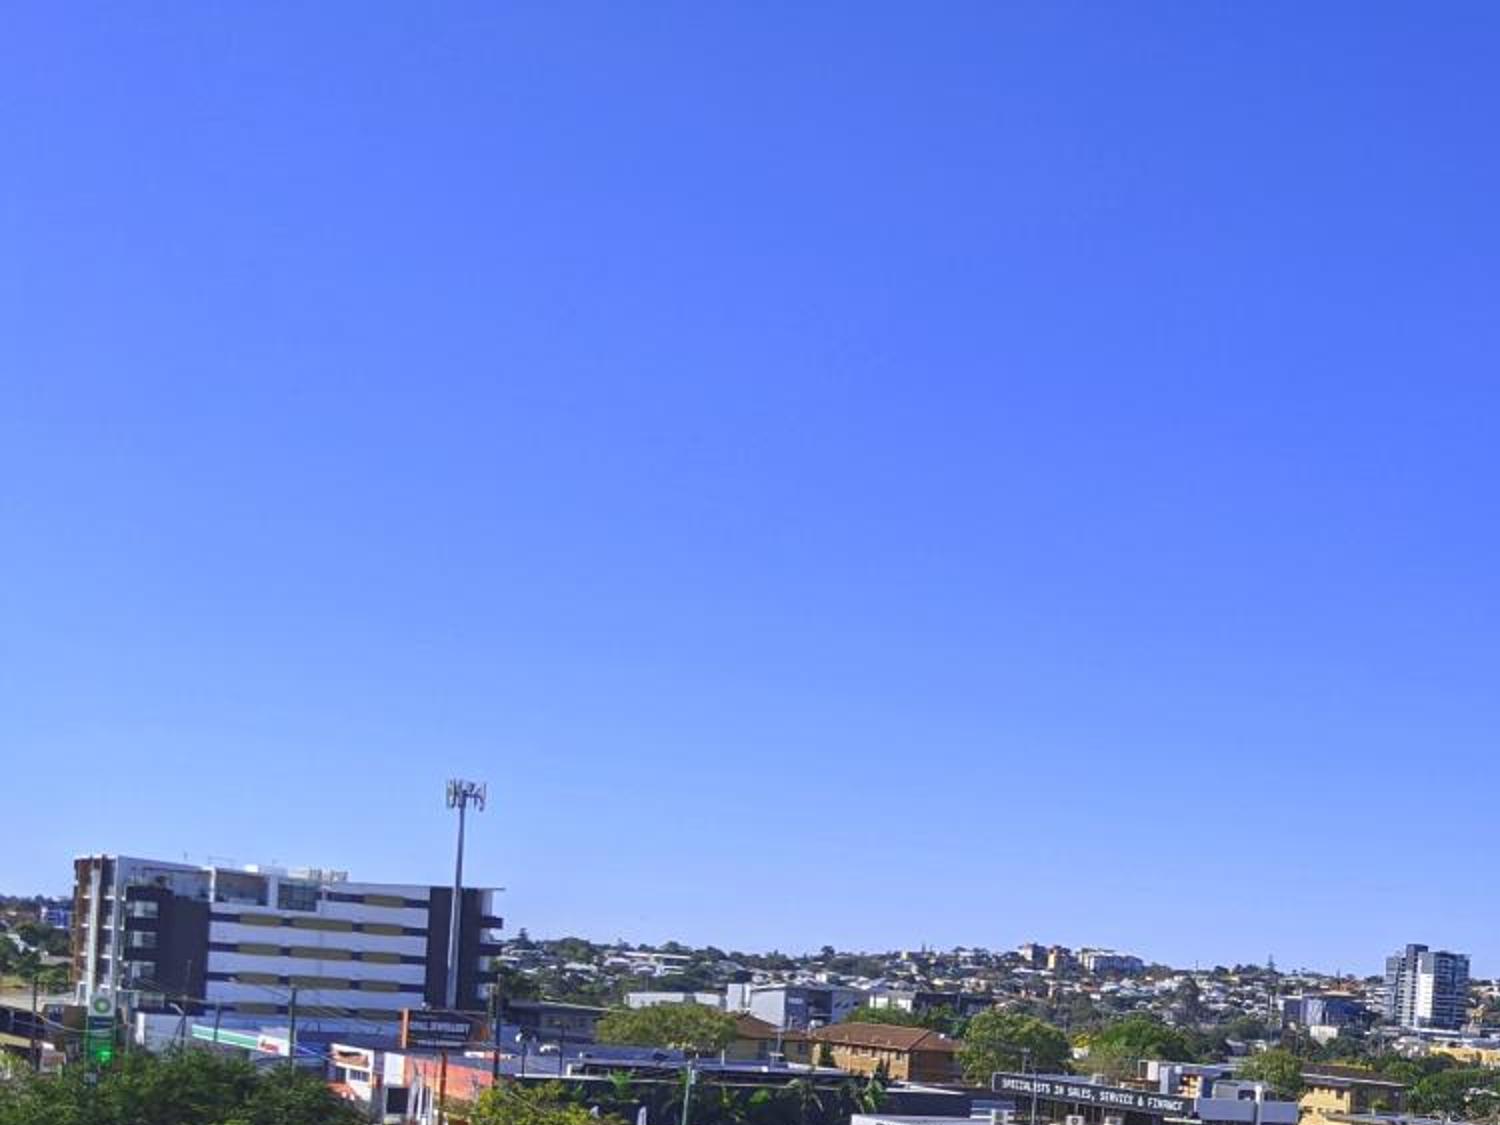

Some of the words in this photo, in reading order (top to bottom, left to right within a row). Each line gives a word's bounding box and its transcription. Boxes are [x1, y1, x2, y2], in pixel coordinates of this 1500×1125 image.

[1053, 1084, 1064, 1095] IN
[1067, 1086, 1095, 1102] SALES,
[1099, 1091, 1133, 1105] SERVICE
[1137, 1095, 1145, 1106] &
[1147, 1097, 1184, 1111] FINANCE
